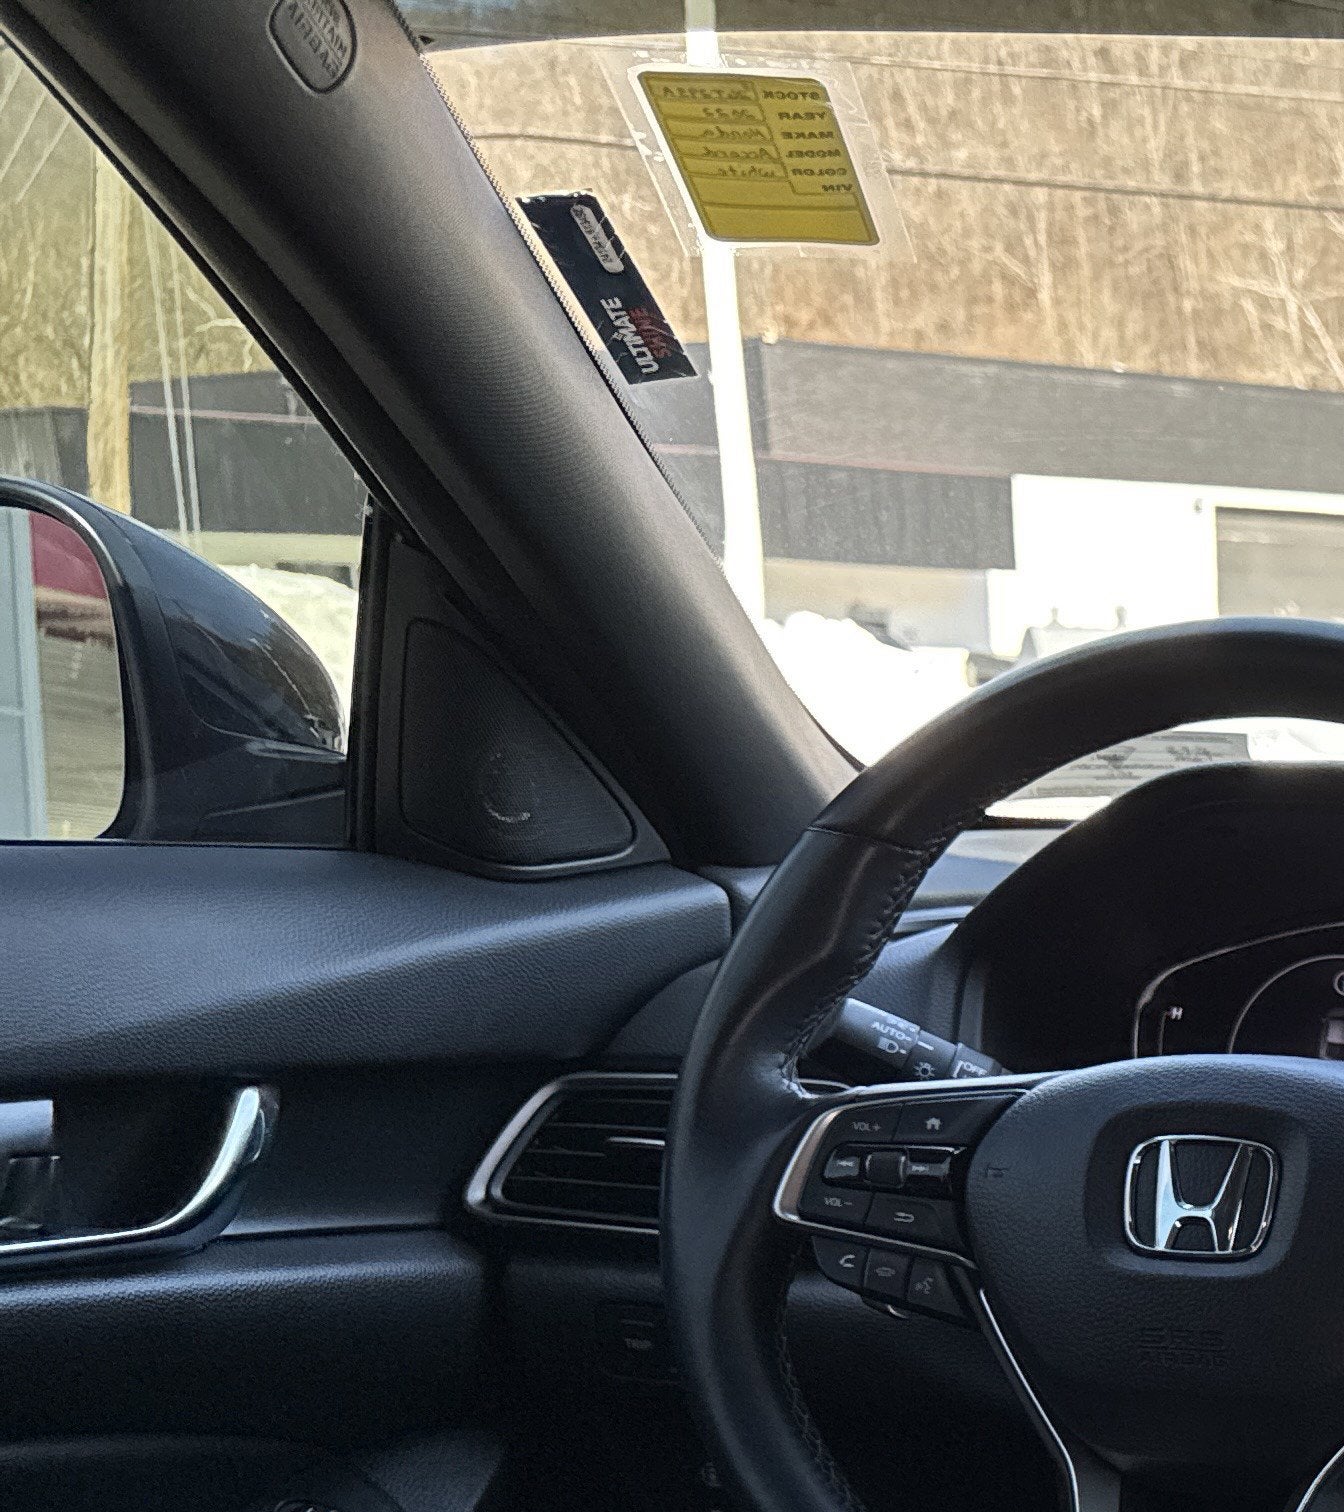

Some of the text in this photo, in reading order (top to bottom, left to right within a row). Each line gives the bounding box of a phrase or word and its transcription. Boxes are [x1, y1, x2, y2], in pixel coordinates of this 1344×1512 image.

[600, 296, 660, 375] ULTIMATE
[627, 307, 672, 359] SHINE
[871, 1021, 906, 1041] AUTO
